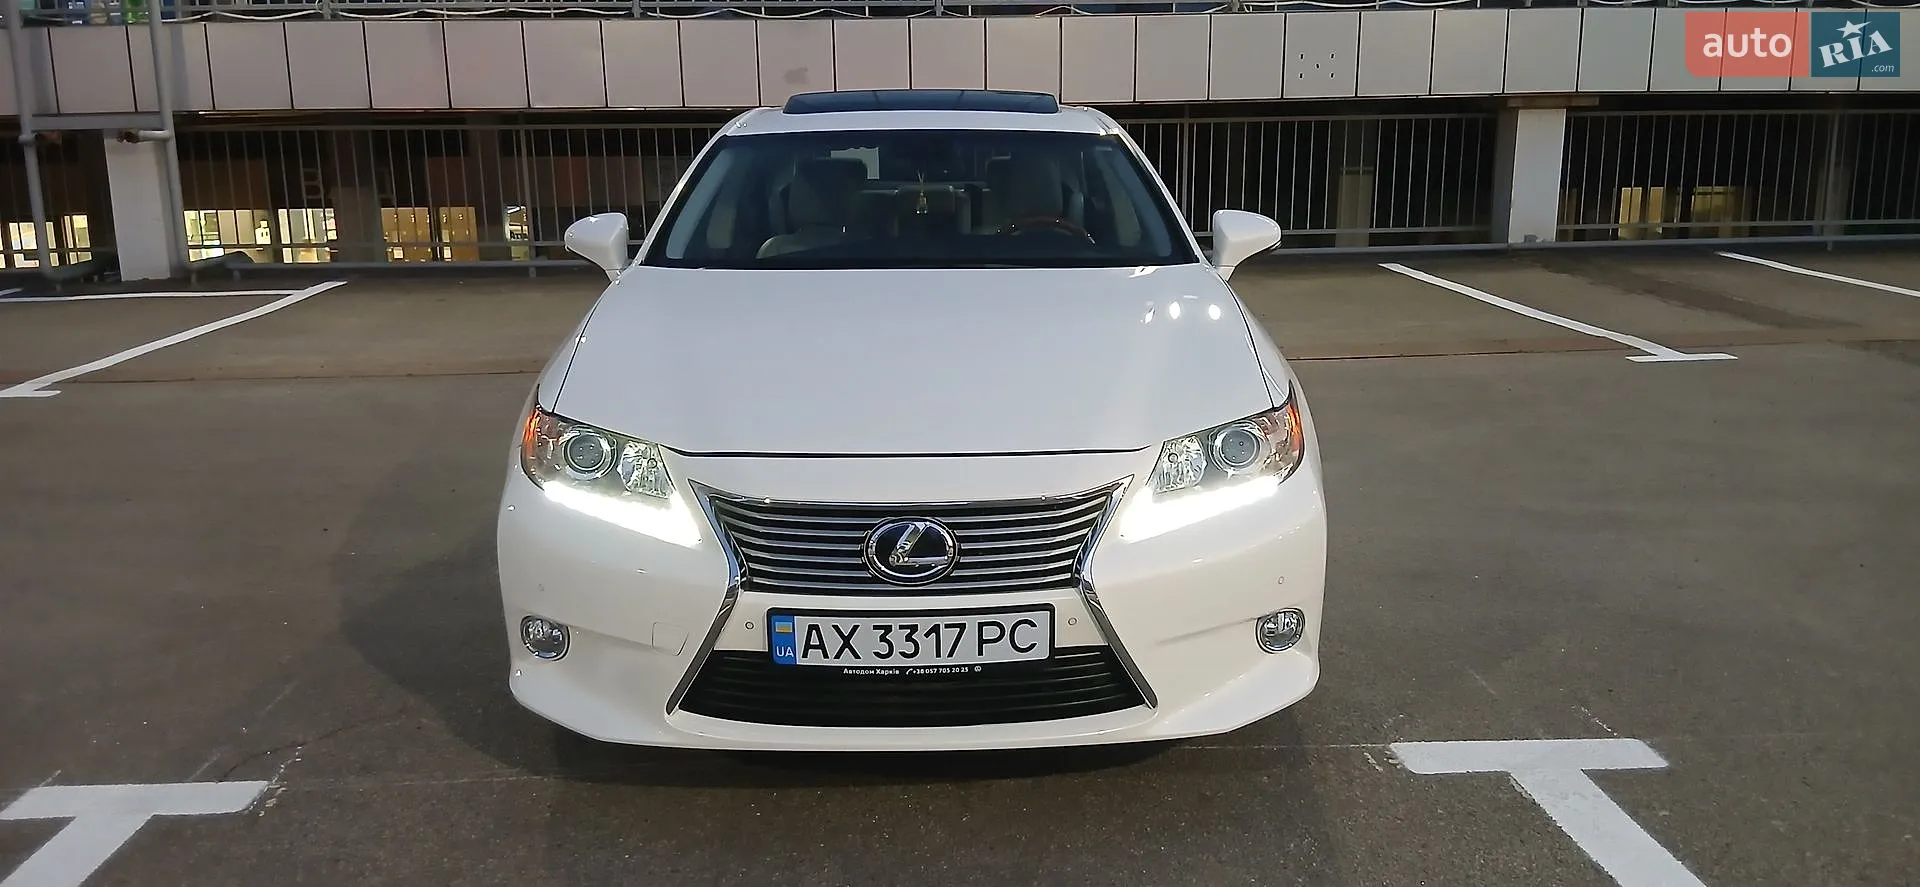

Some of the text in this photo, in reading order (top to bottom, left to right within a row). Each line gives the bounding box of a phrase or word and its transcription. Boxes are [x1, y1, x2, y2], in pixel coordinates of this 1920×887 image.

[776, 646, 794, 658] UA
[801, 618, 1039, 660] AX 3317 PC
